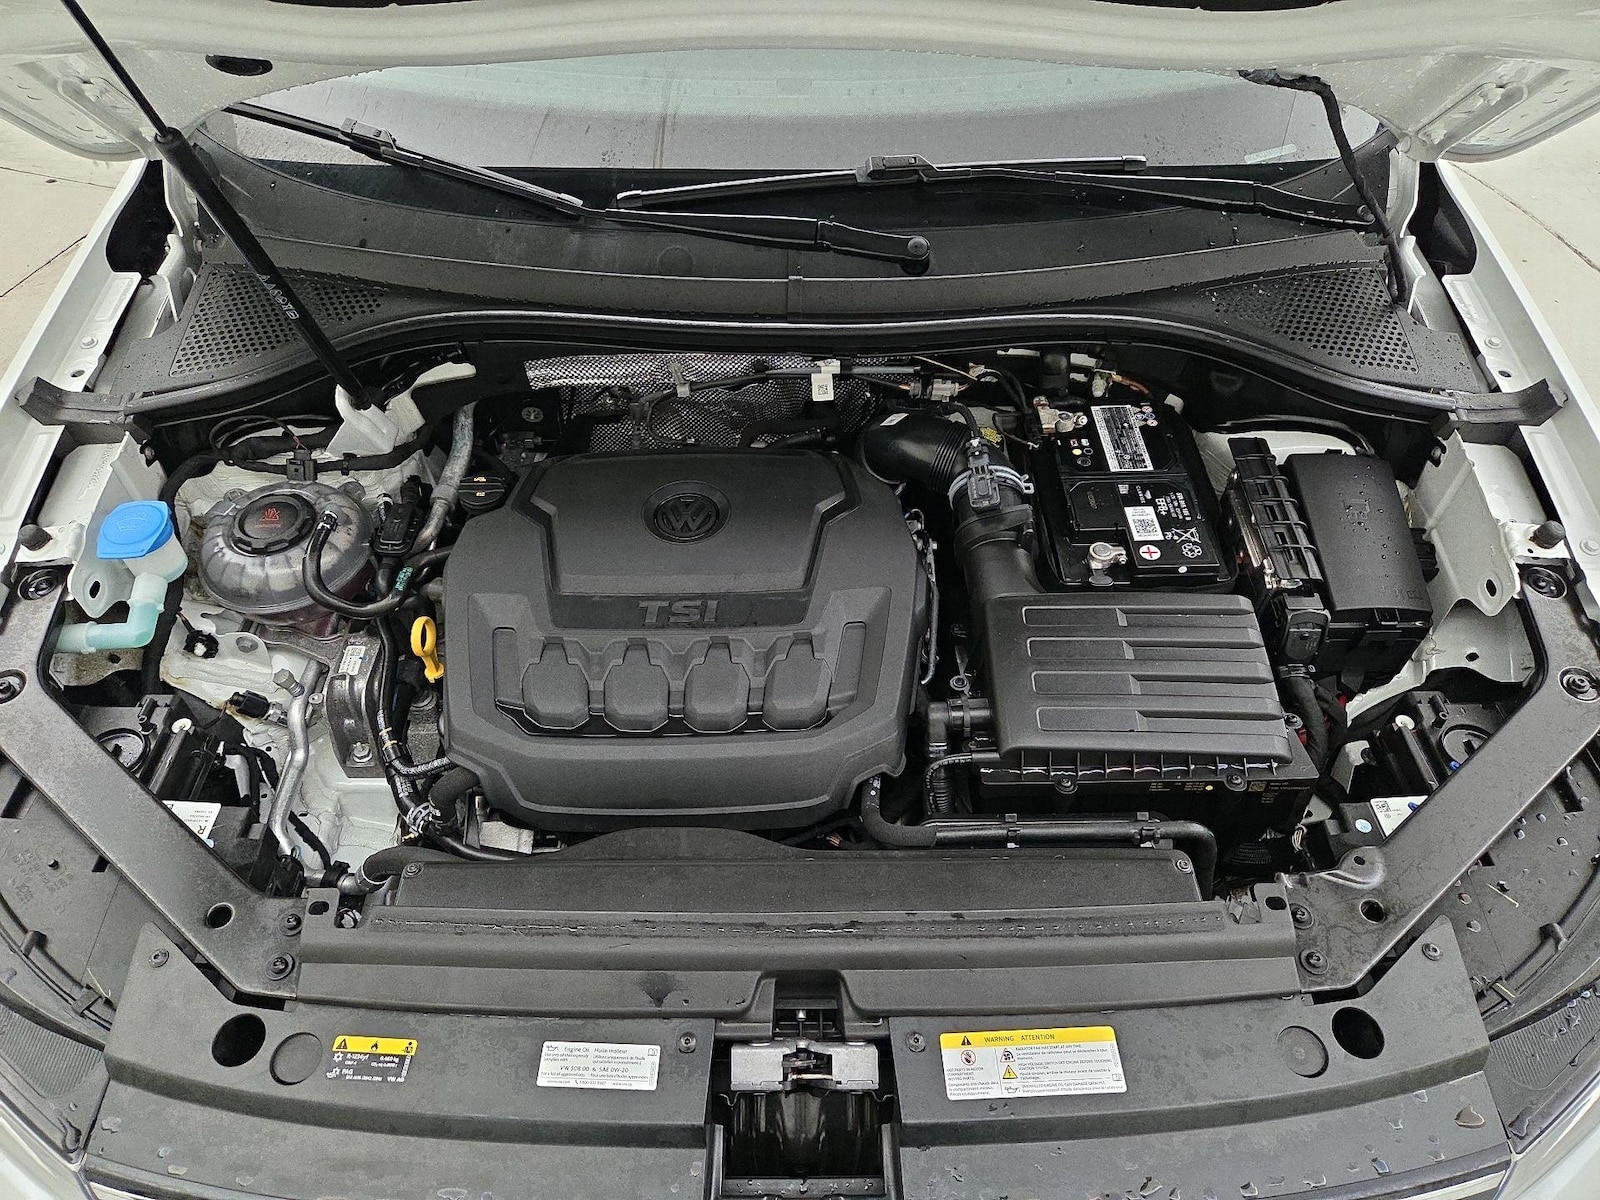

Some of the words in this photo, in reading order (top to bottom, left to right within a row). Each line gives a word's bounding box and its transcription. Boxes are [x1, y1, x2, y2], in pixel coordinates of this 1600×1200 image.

[1155, 498, 1168, 516] EFB+
[638, 600, 719, 622] TSI
[198, 825, 206, 834] R
